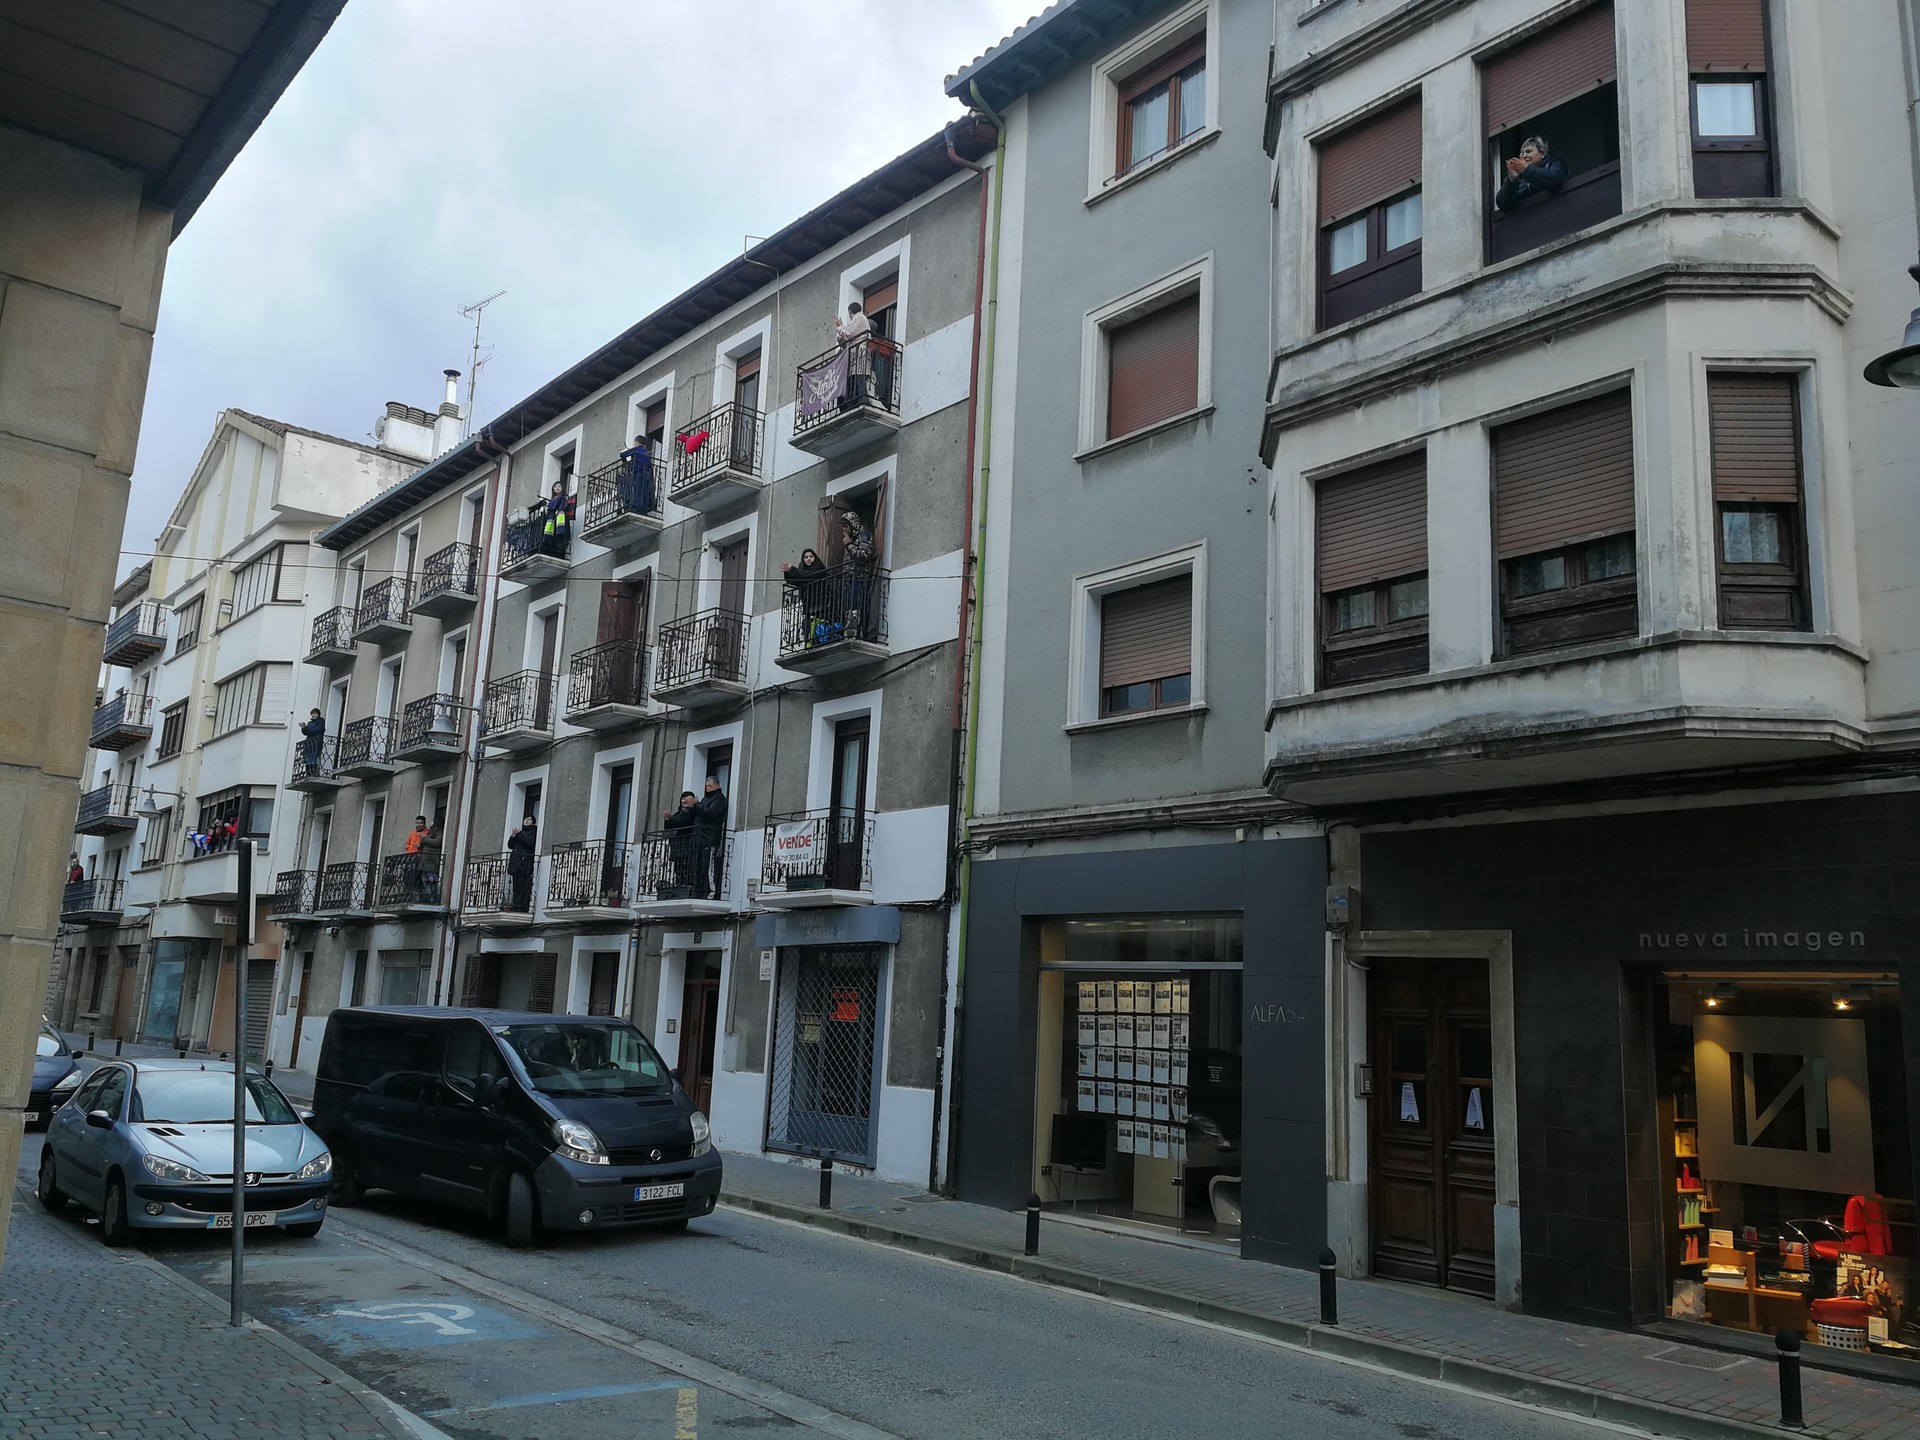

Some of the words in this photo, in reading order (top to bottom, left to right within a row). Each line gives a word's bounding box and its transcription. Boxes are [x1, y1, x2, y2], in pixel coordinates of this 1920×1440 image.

[778, 834, 812, 849] VENDE
[1639, 932, 1728, 948] nueva
[1744, 928, 1865, 951] imagen
[642, 1188, 664, 1199] 3122
[667, 1185, 682, 1196] FCL
[246, 1214, 267, 1226] DPC
